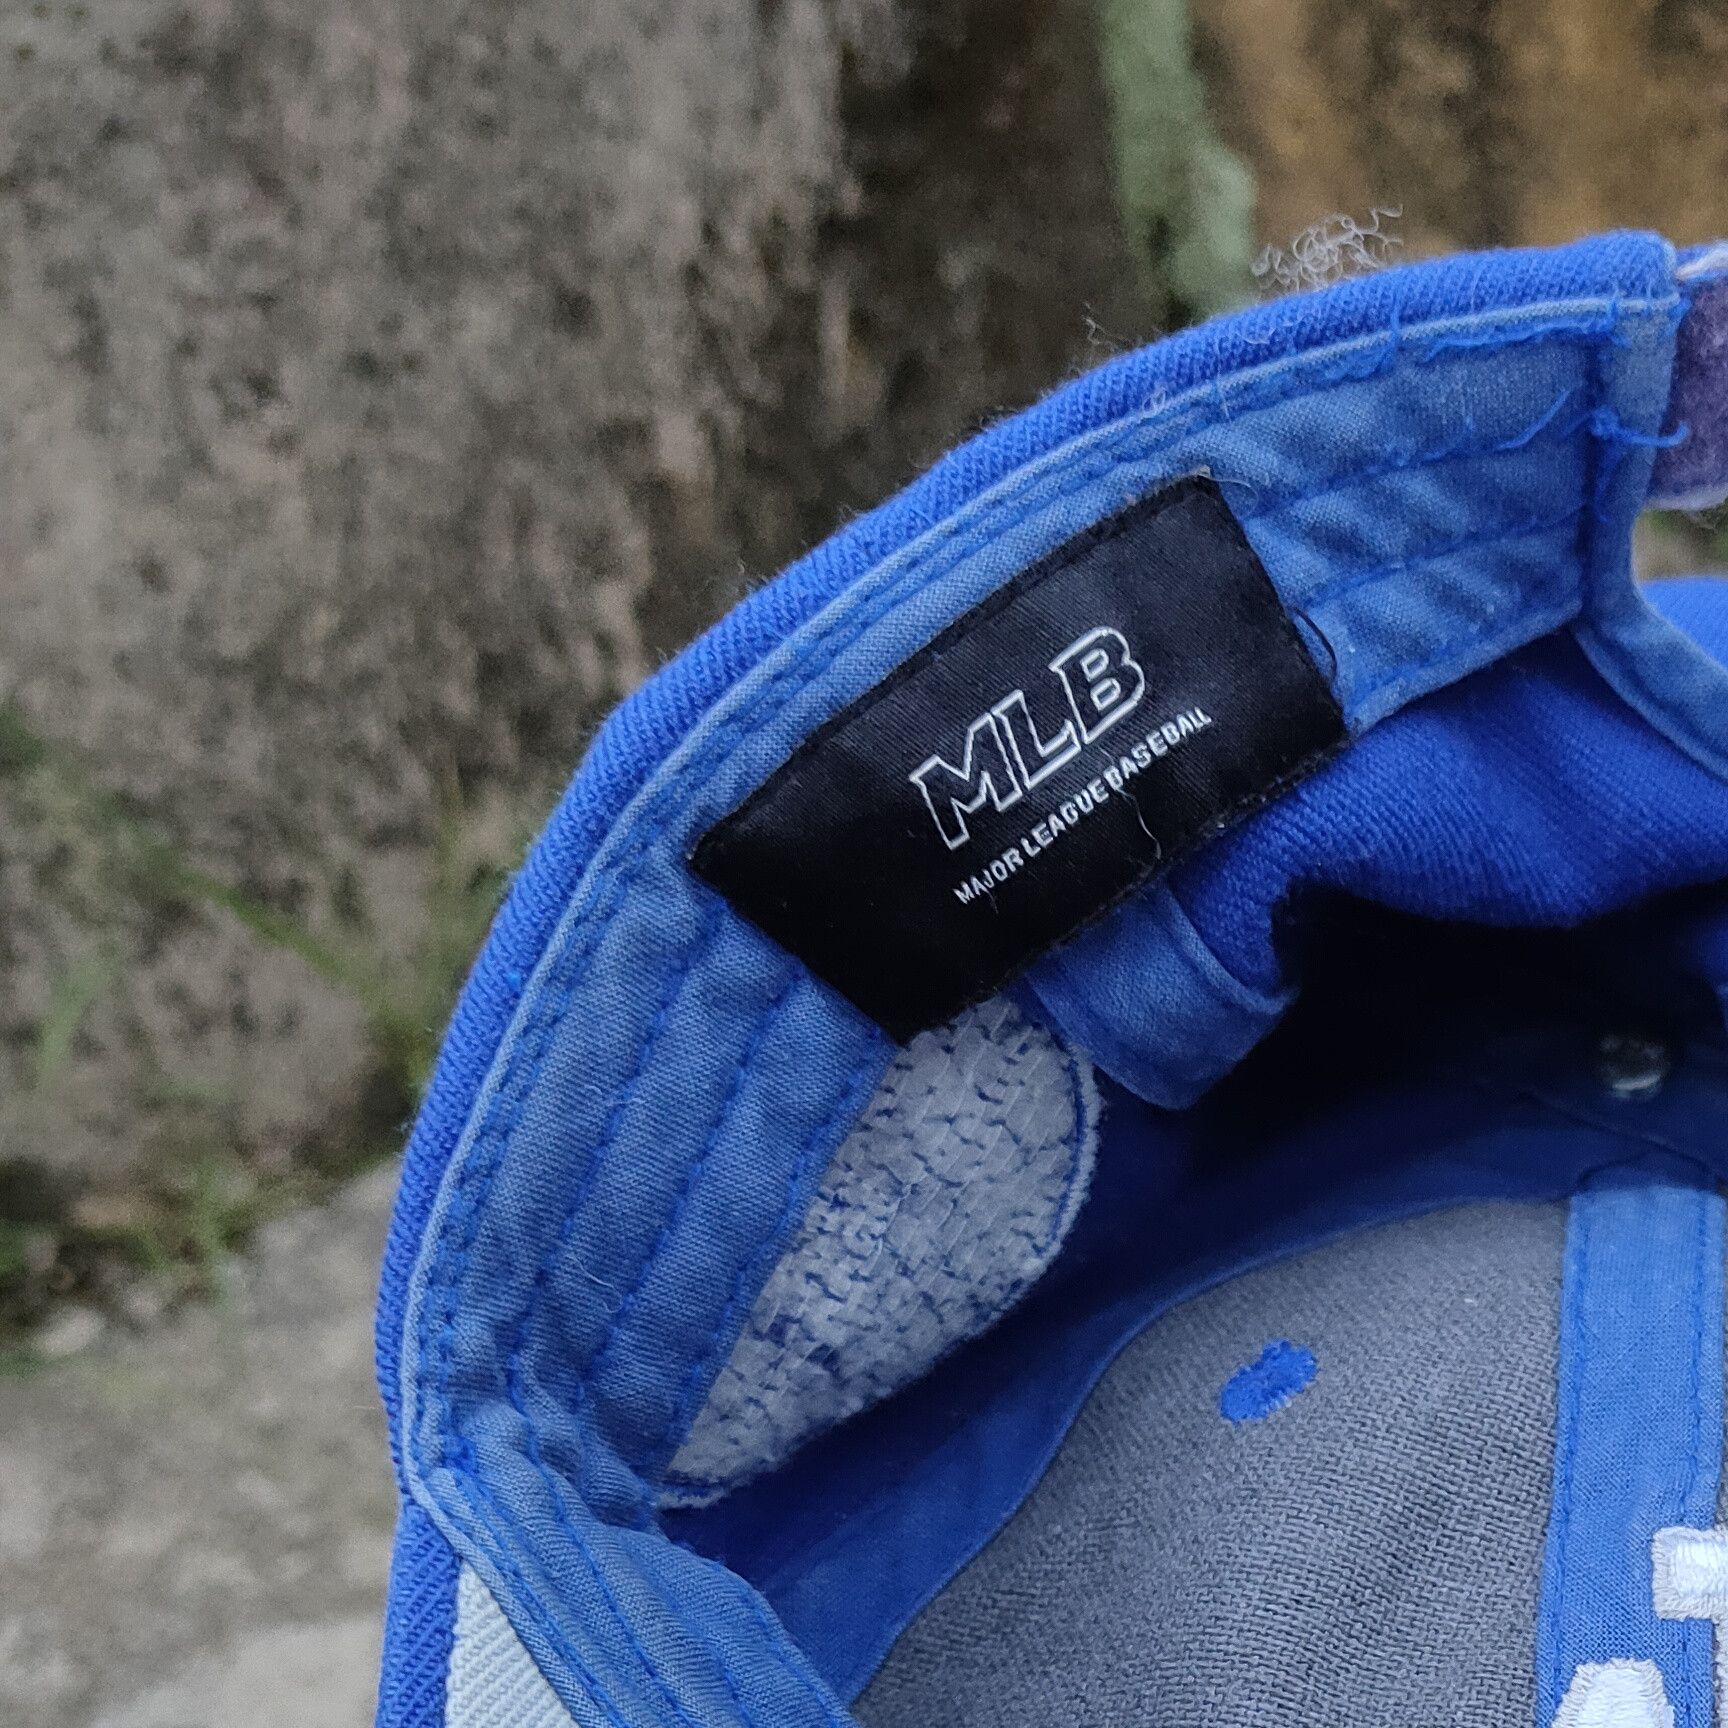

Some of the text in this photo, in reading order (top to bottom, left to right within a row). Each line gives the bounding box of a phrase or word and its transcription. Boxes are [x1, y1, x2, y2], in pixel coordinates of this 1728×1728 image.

[909, 625, 1146, 850] MLB
[952, 706, 1213, 905] MAJOR LEAGUE BASEBALL
